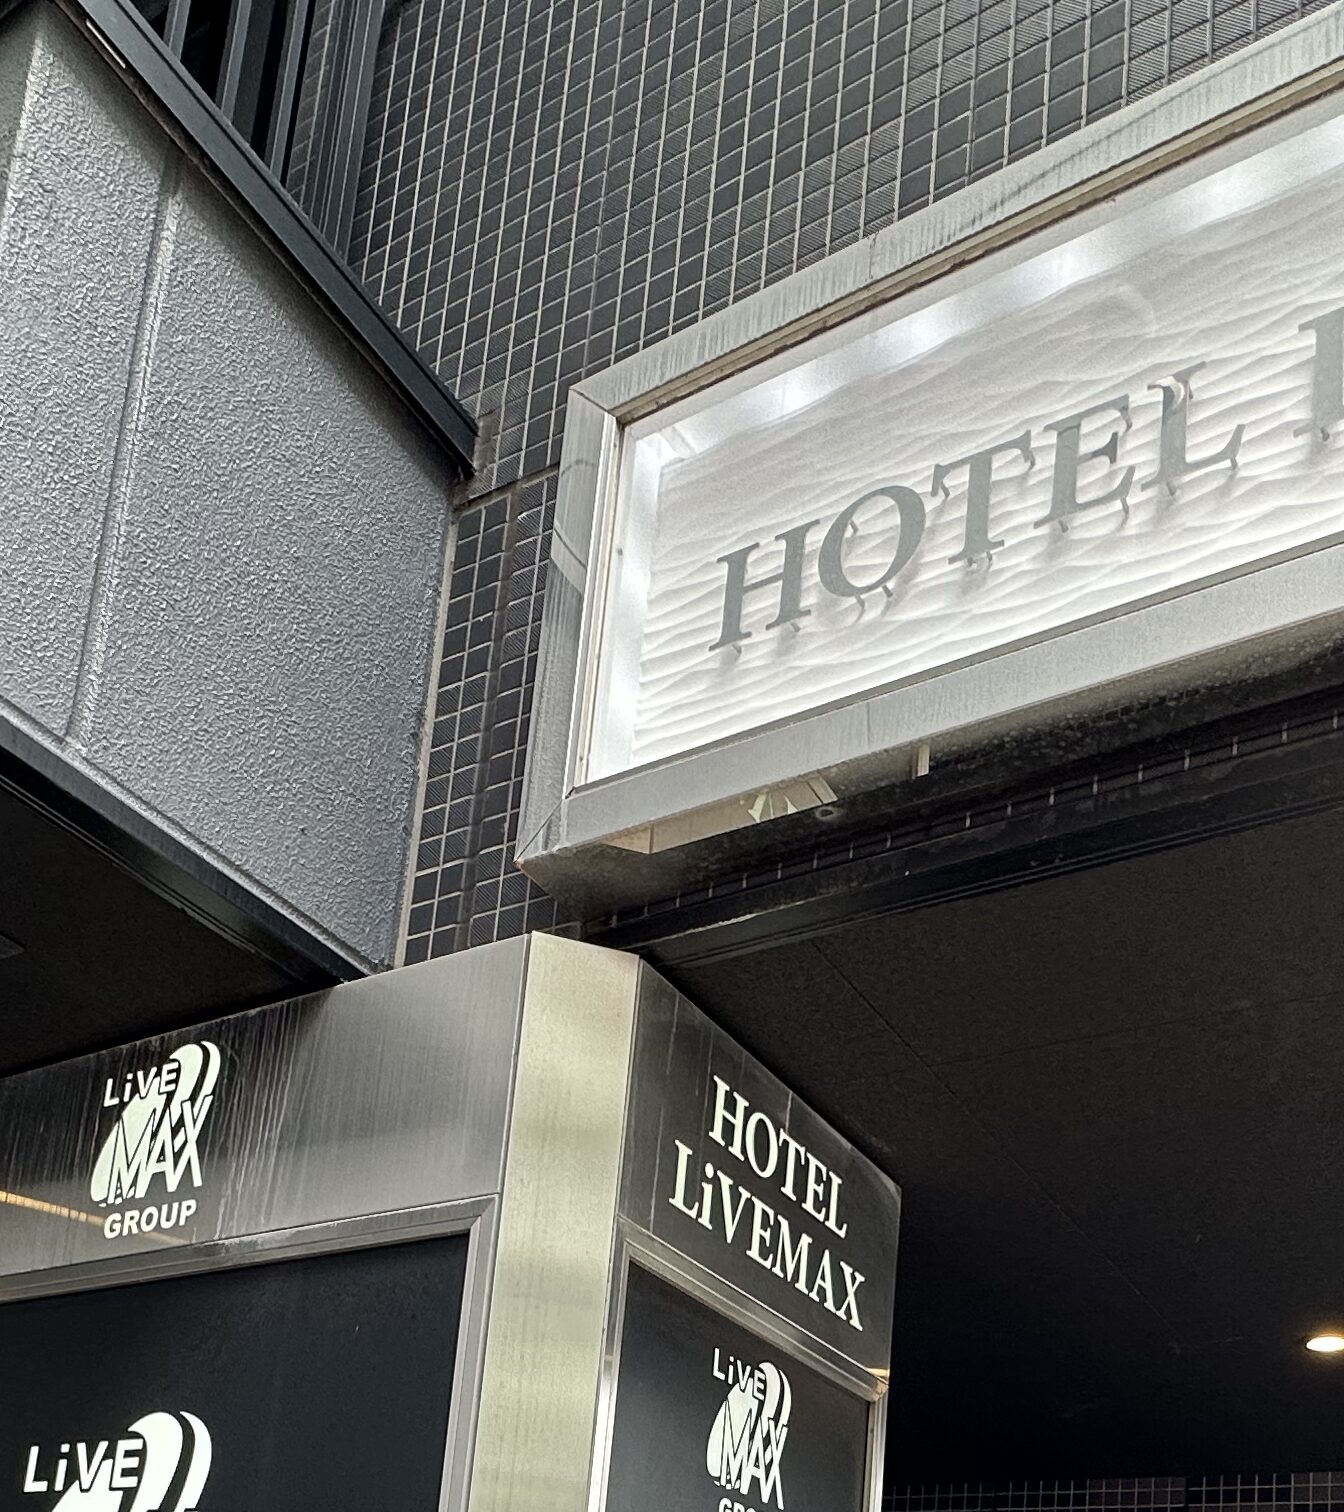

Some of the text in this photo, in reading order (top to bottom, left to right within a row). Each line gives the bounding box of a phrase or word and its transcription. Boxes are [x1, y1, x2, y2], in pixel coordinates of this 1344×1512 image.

[708, 360, 1246, 655] HOTEL
[108, 1096, 213, 1204] MAX
[709, 1074, 849, 1239] HOTEL
[105, 1199, 197, 1240] GROUP
[668, 1139, 866, 1332] LiVEMAX
[720, 1399, 789, 1511] MAX
